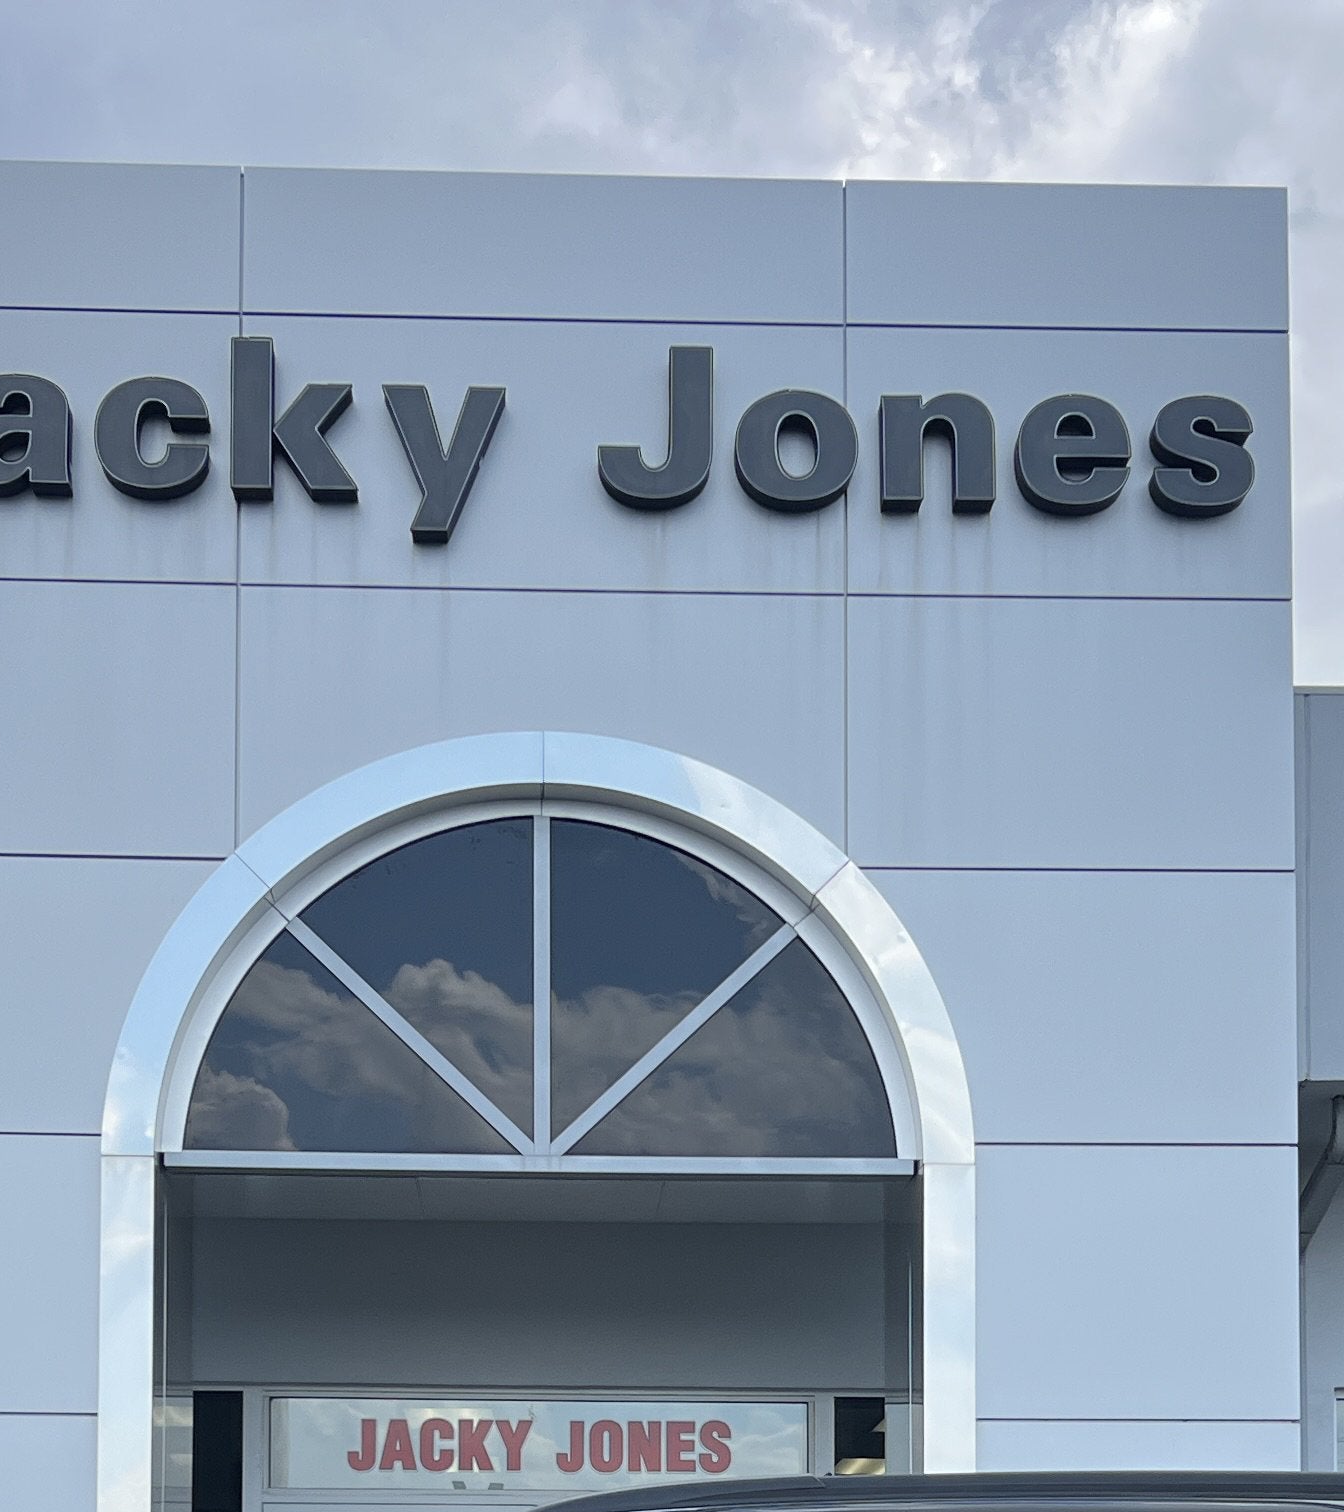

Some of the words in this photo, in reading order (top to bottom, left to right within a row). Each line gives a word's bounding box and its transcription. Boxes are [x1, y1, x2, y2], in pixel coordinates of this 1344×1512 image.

[597, 345, 1255, 517] Jones
[347, 1418, 532, 1474] JACKY
[556, 1419, 733, 1475] JONES
